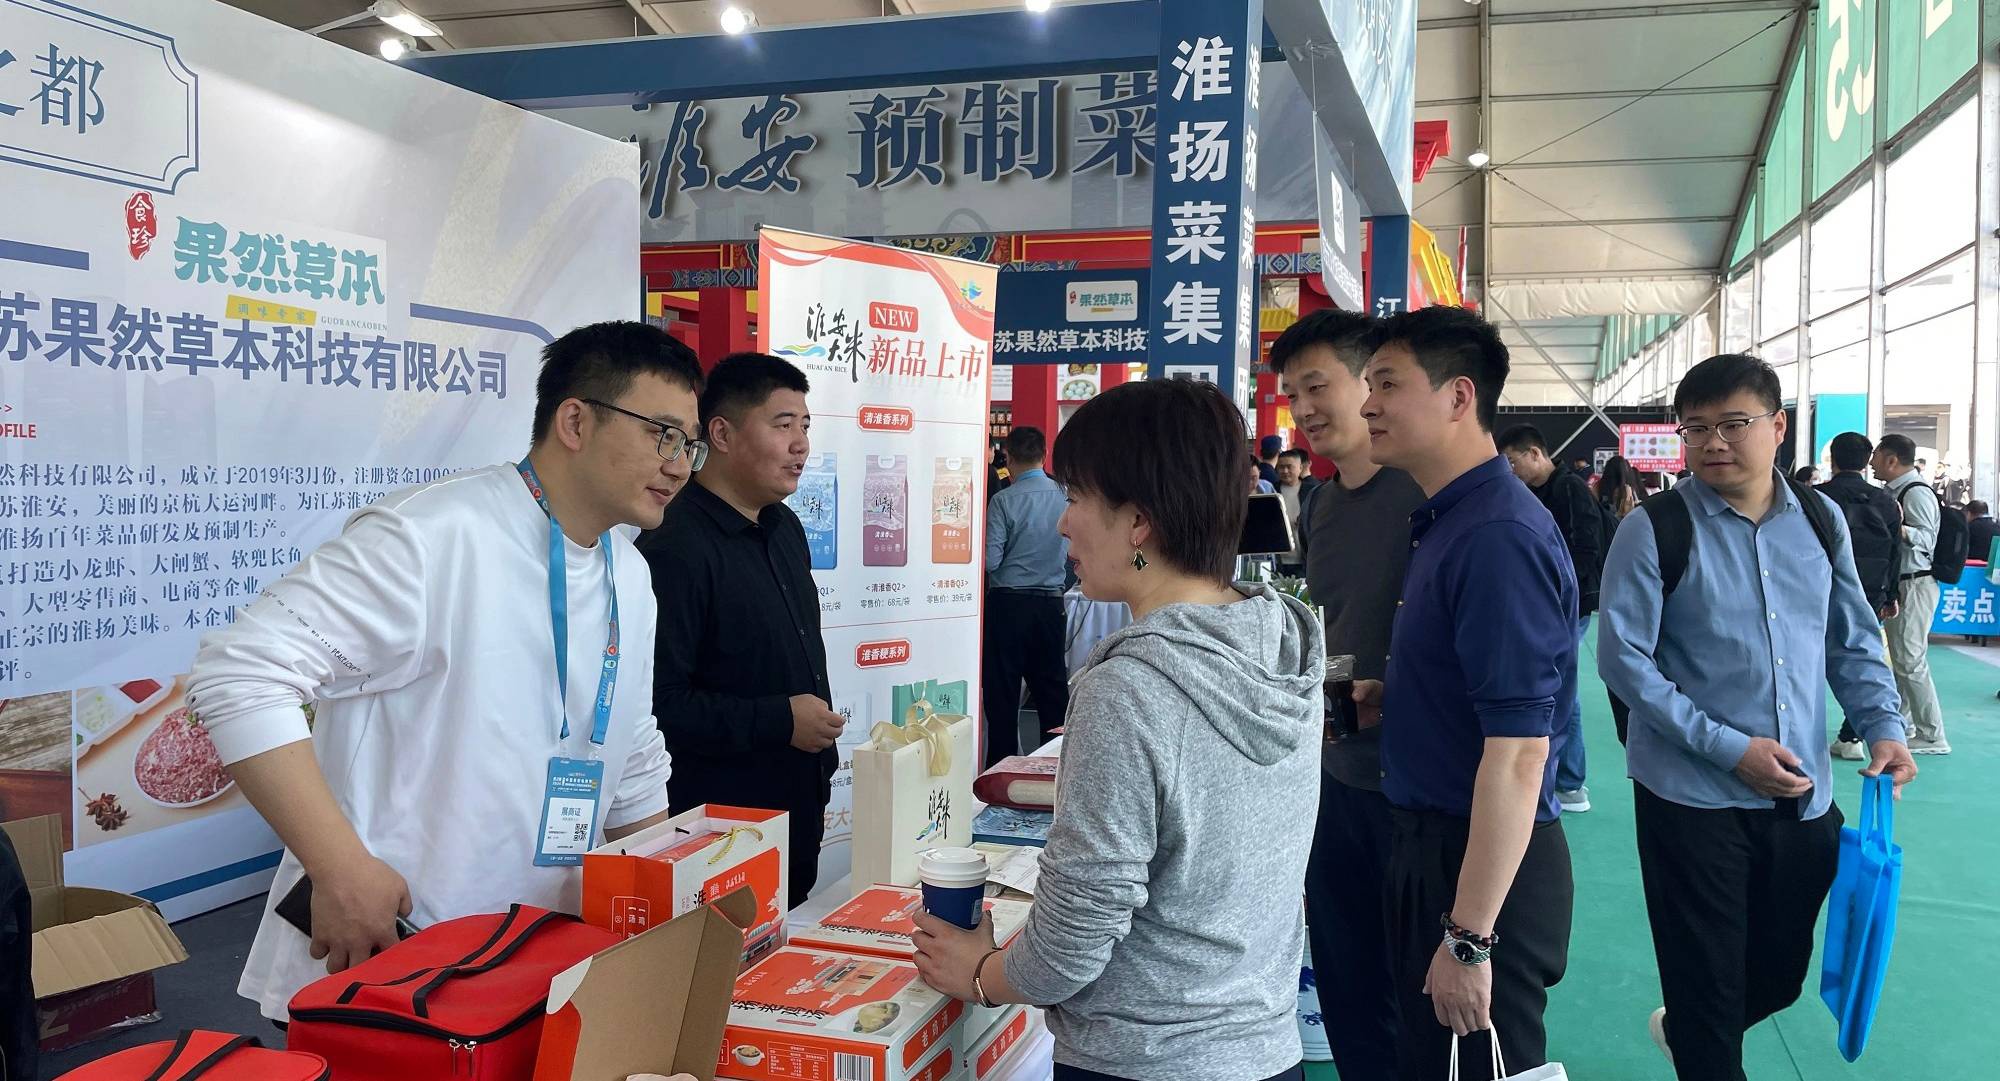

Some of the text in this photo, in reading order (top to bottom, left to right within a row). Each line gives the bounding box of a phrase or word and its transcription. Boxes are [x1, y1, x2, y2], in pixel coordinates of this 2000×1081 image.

[846, 72, 1156, 190] 预制菜
[173, 216, 386, 306] 果然草本
[874, 306, 915, 329] NEW
[0, 291, 508, 400] 苏果然草本科技有限公司
[994, 327, 1149, 353] 苏果然草本科技
[866, 334, 985, 382] 新品上市
[0, 423, 37, 438] FILE
[864, 412, 910, 426] 清淮香系列
[1941, 586, 1996, 624] 卖点
[824, 806, 853, 830] 安大
